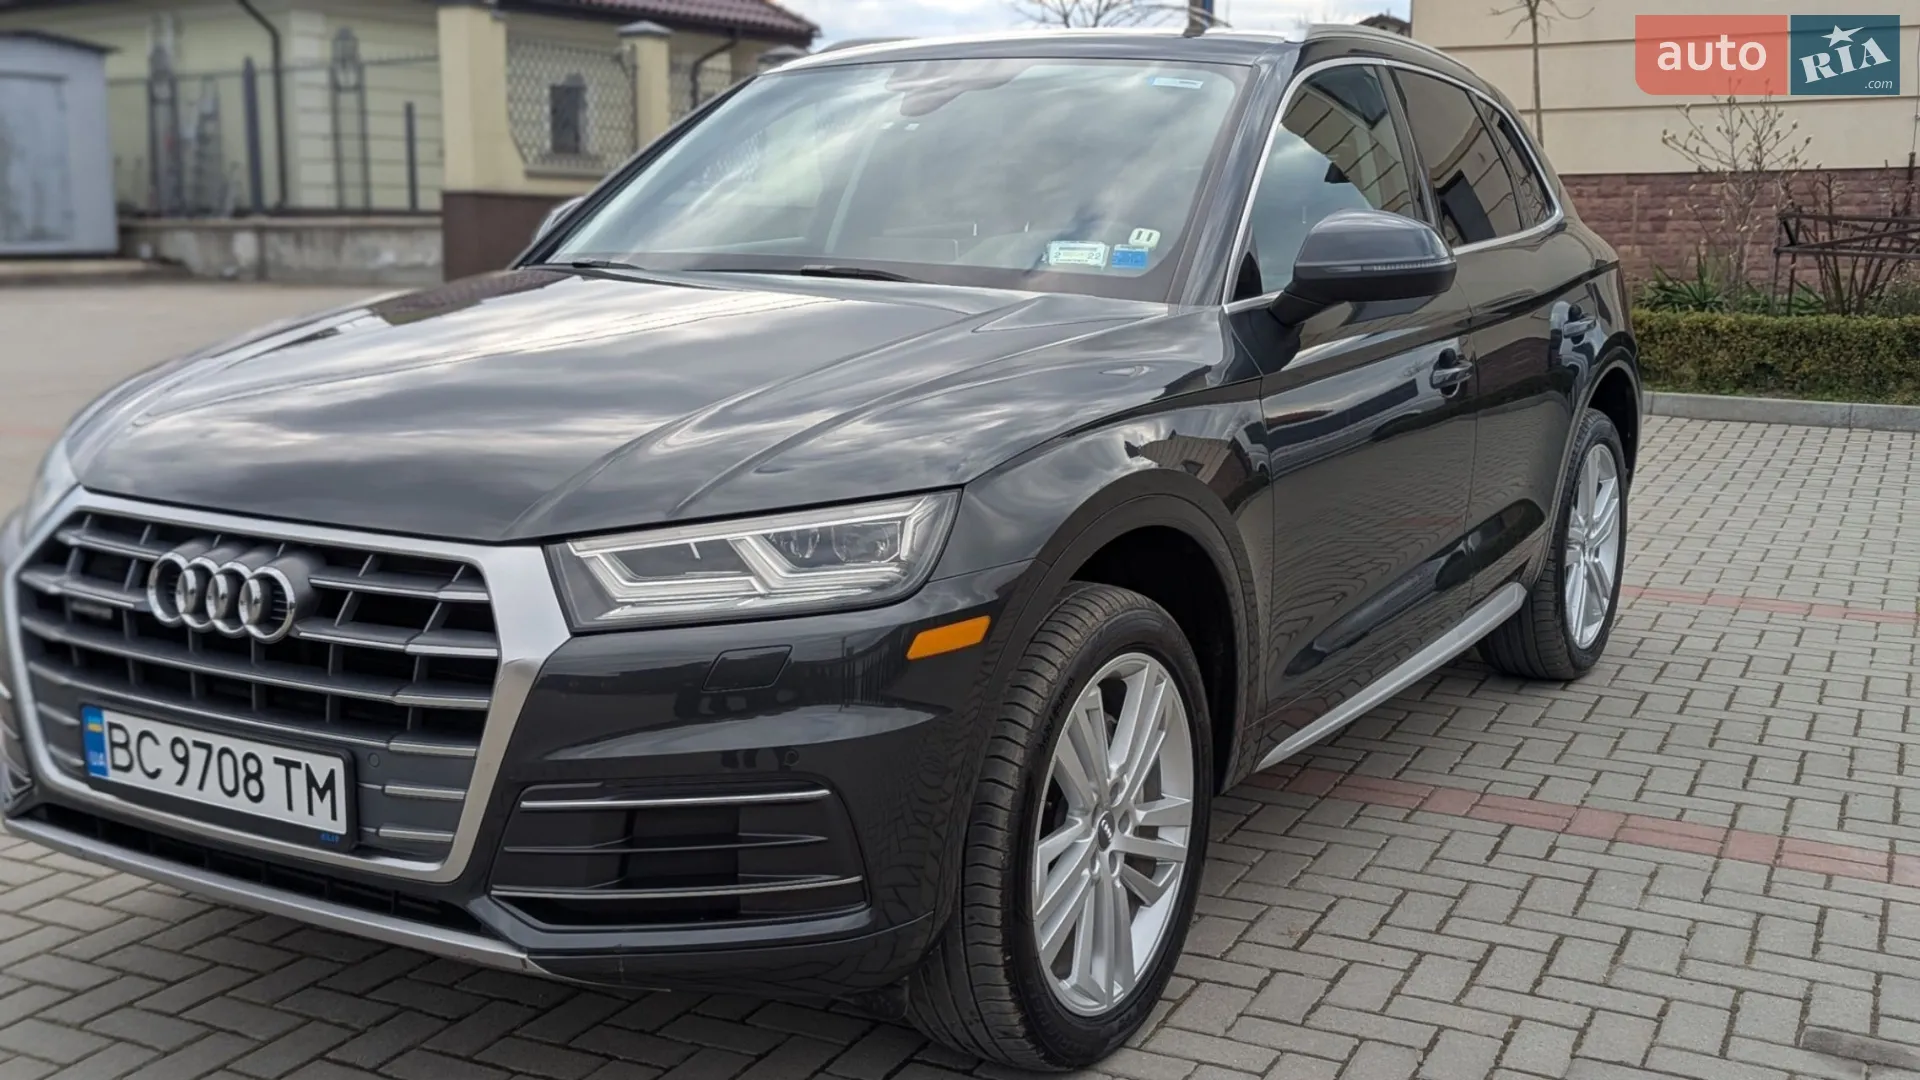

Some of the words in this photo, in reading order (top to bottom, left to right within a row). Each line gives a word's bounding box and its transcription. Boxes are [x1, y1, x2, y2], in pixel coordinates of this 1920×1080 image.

[106, 721, 163, 780] BC
[170, 736, 265, 804] 9708
[273, 756, 338, 822] TM
